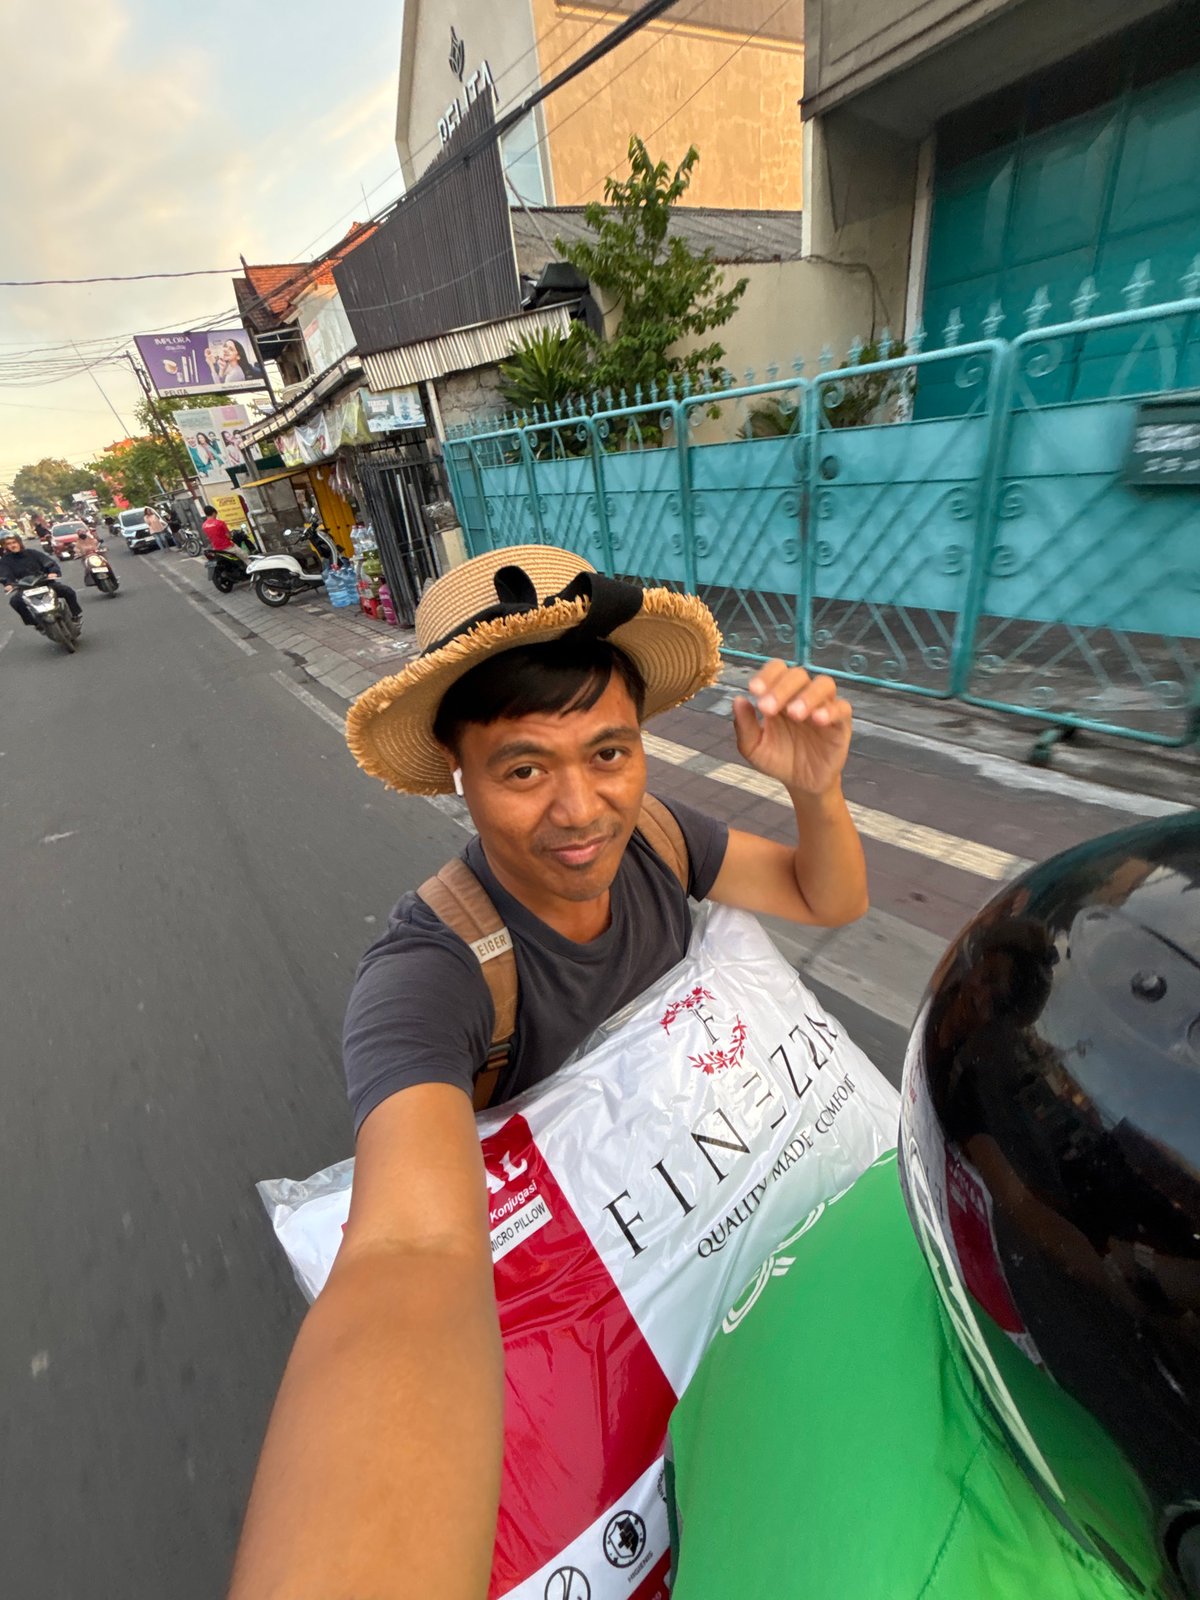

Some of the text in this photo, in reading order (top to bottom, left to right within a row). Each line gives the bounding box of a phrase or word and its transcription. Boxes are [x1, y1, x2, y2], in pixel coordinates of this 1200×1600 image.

[476, 933, 508, 957] EIGER
[489, 1178, 538, 1223] Konjugasi
[696, 1176, 768, 1259] QUALITY
[771, 1129, 814, 1182] MADE
[513, 1201, 547, 1235] PILLOW
